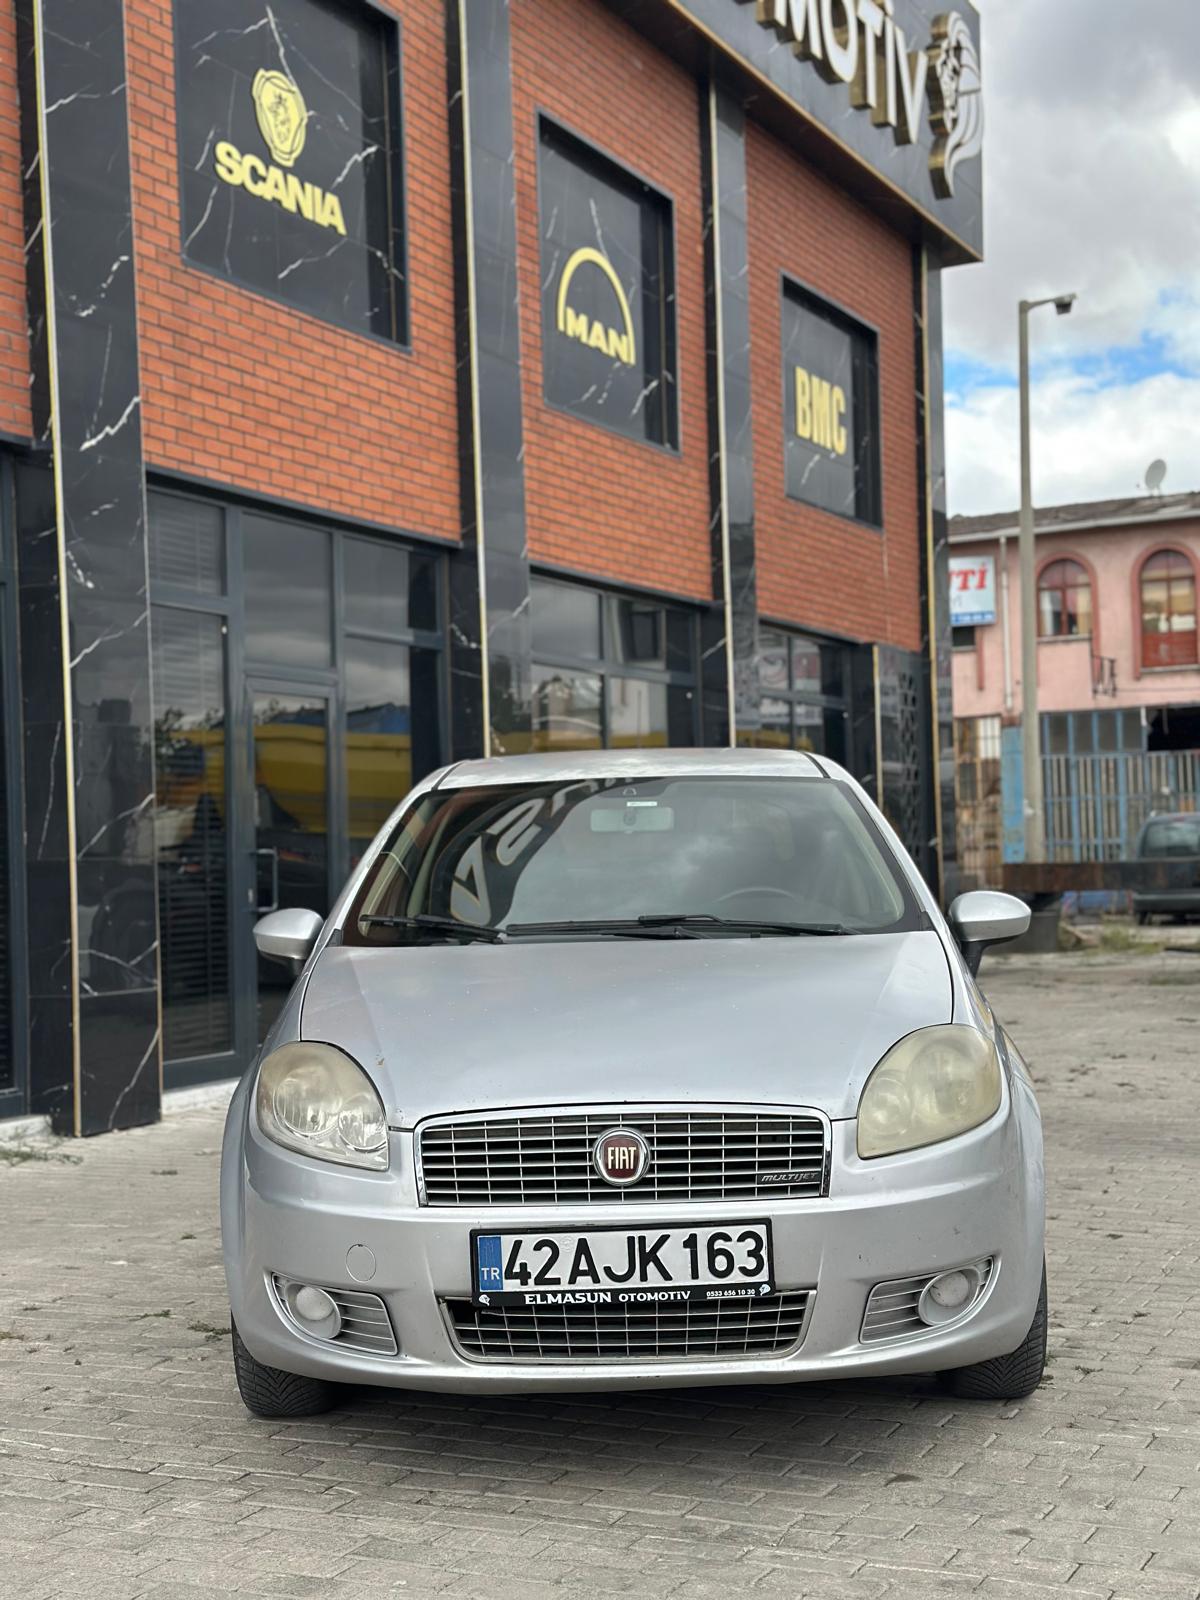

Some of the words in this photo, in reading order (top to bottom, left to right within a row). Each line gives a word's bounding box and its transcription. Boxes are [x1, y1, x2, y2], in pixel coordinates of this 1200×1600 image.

[215, 141, 347, 236] SCANIA
[566, 306, 628, 364] MAN
[795, 366, 847, 455] BMC
[607, 1146, 636, 1170] FIAT
[761, 1172, 818, 1182] MULTIJET
[481, 1267, 500, 1280] TR
[524, 1291, 612, 1305] ELMASUN
